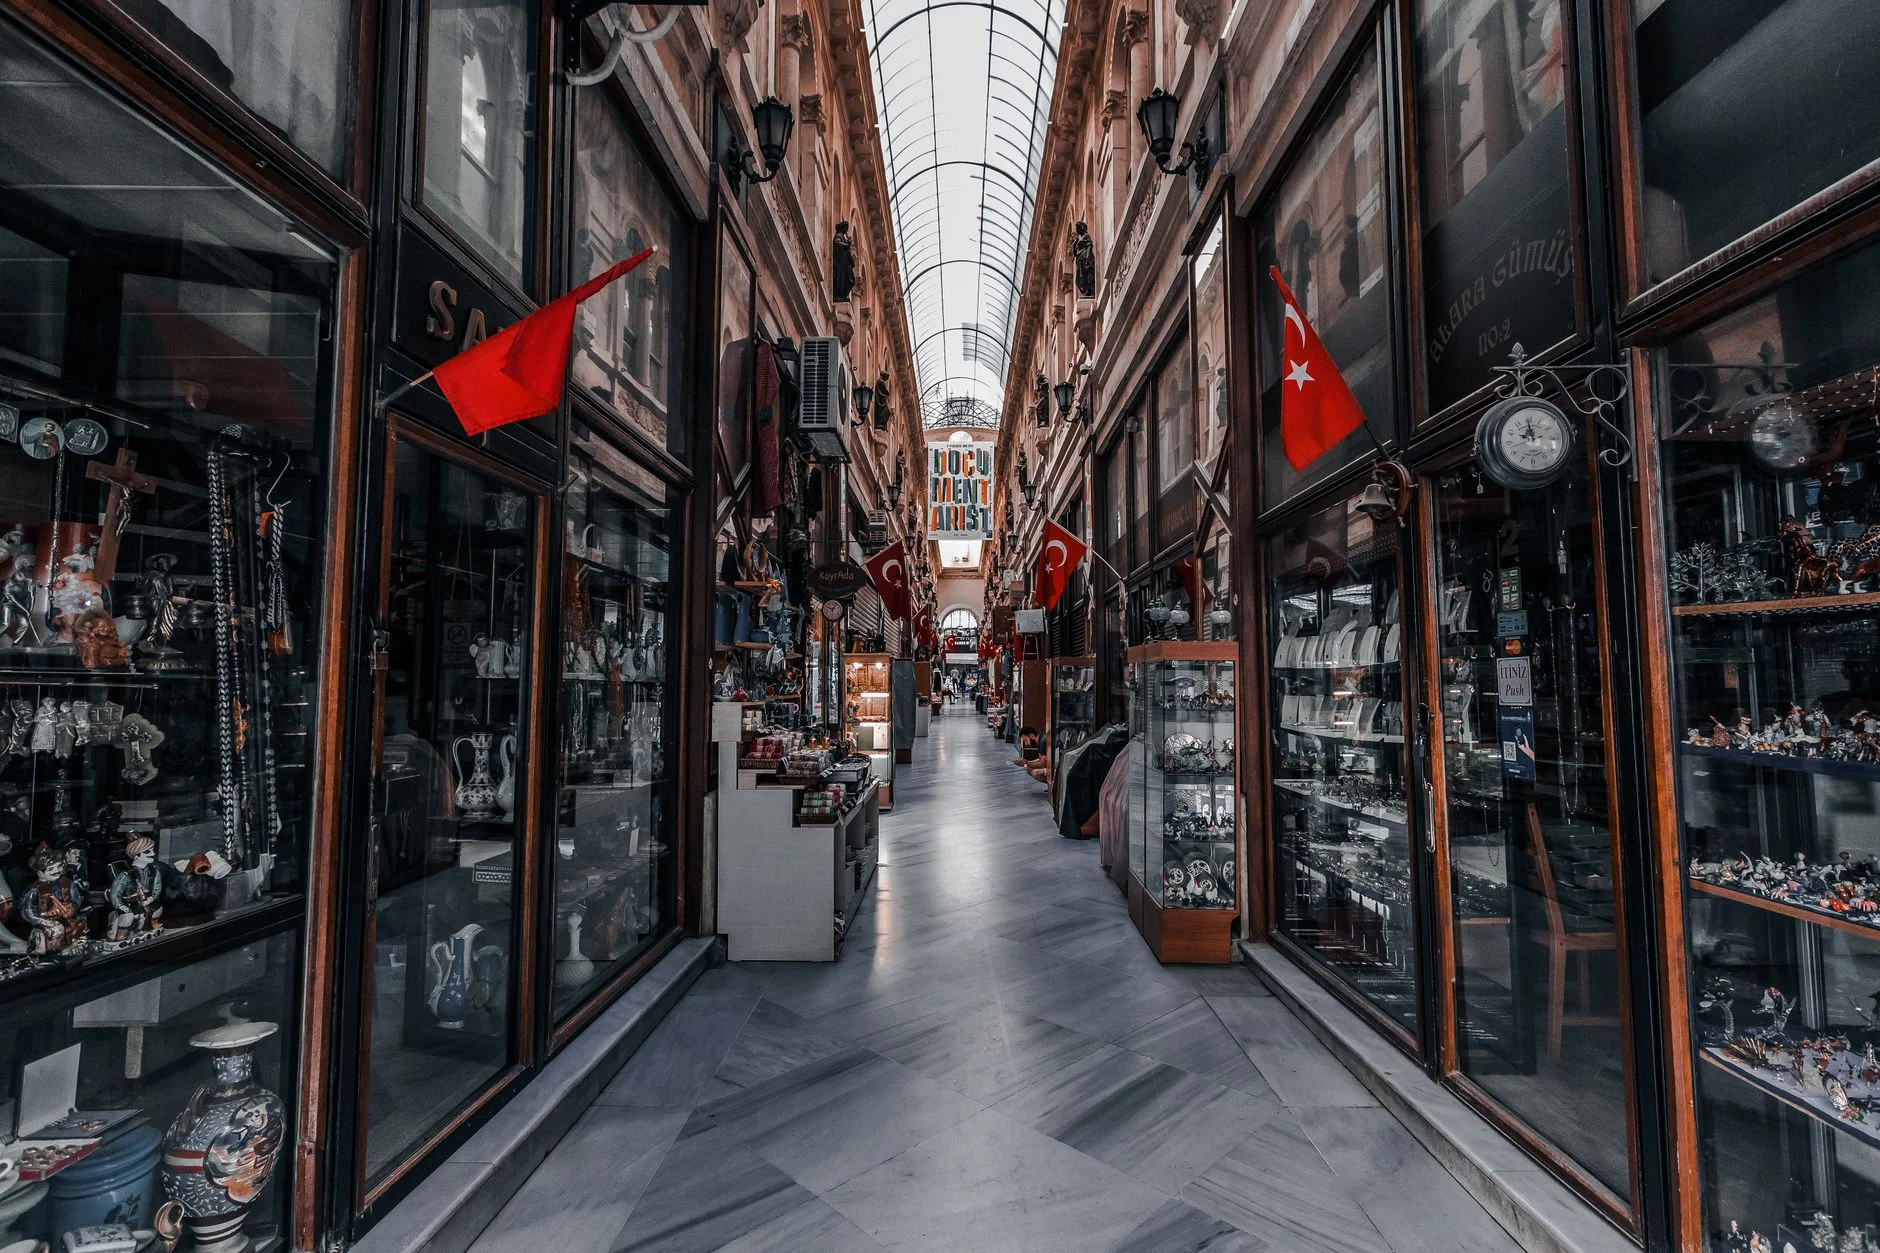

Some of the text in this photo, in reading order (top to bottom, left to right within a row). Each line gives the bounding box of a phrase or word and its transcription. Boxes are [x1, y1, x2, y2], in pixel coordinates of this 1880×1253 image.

[426, 280, 504, 353] SA
[934, 448, 990, 477] DOCU
[931, 477, 990, 505] MENT
[1505, 683, 1525, 697] Push
